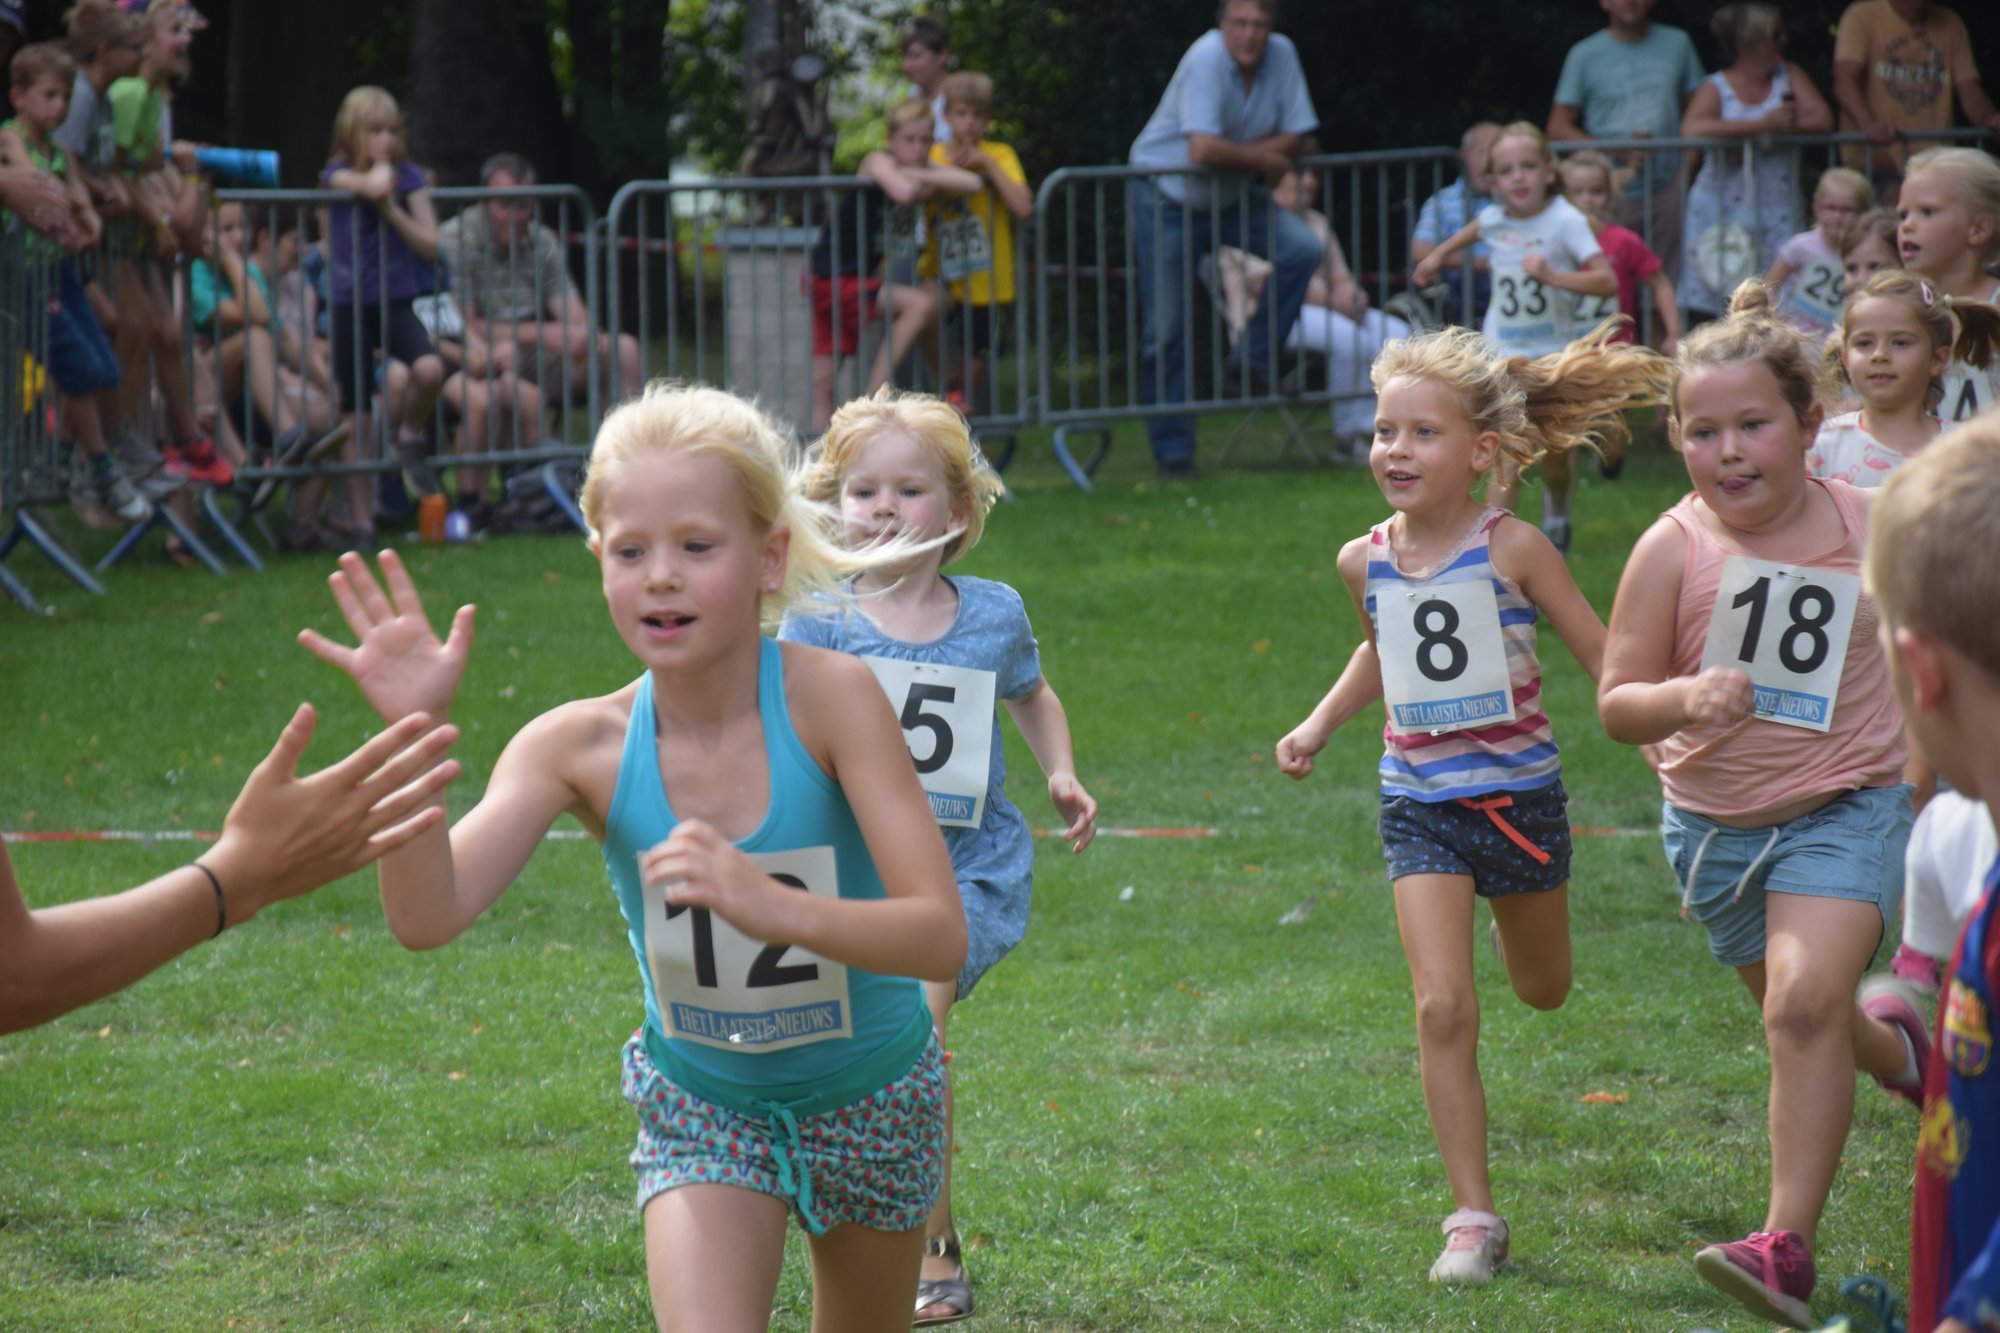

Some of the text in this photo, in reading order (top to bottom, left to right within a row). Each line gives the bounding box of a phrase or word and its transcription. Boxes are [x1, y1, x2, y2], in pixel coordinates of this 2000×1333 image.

[1499, 277, 1546, 317] 33
[1804, 266, 1845, 306] 29
[1413, 599, 1468, 682] 8
[1732, 576, 1835, 674] 18
[1399, 696, 1503, 724] HET LAATSTE NIEUWS
[1778, 693, 1822, 720] NIEUWS
[900, 682, 956, 774] 5
[664, 873, 818, 988] 12
[678, 1006, 833, 1041] HET LAATSTE NIEUWS
